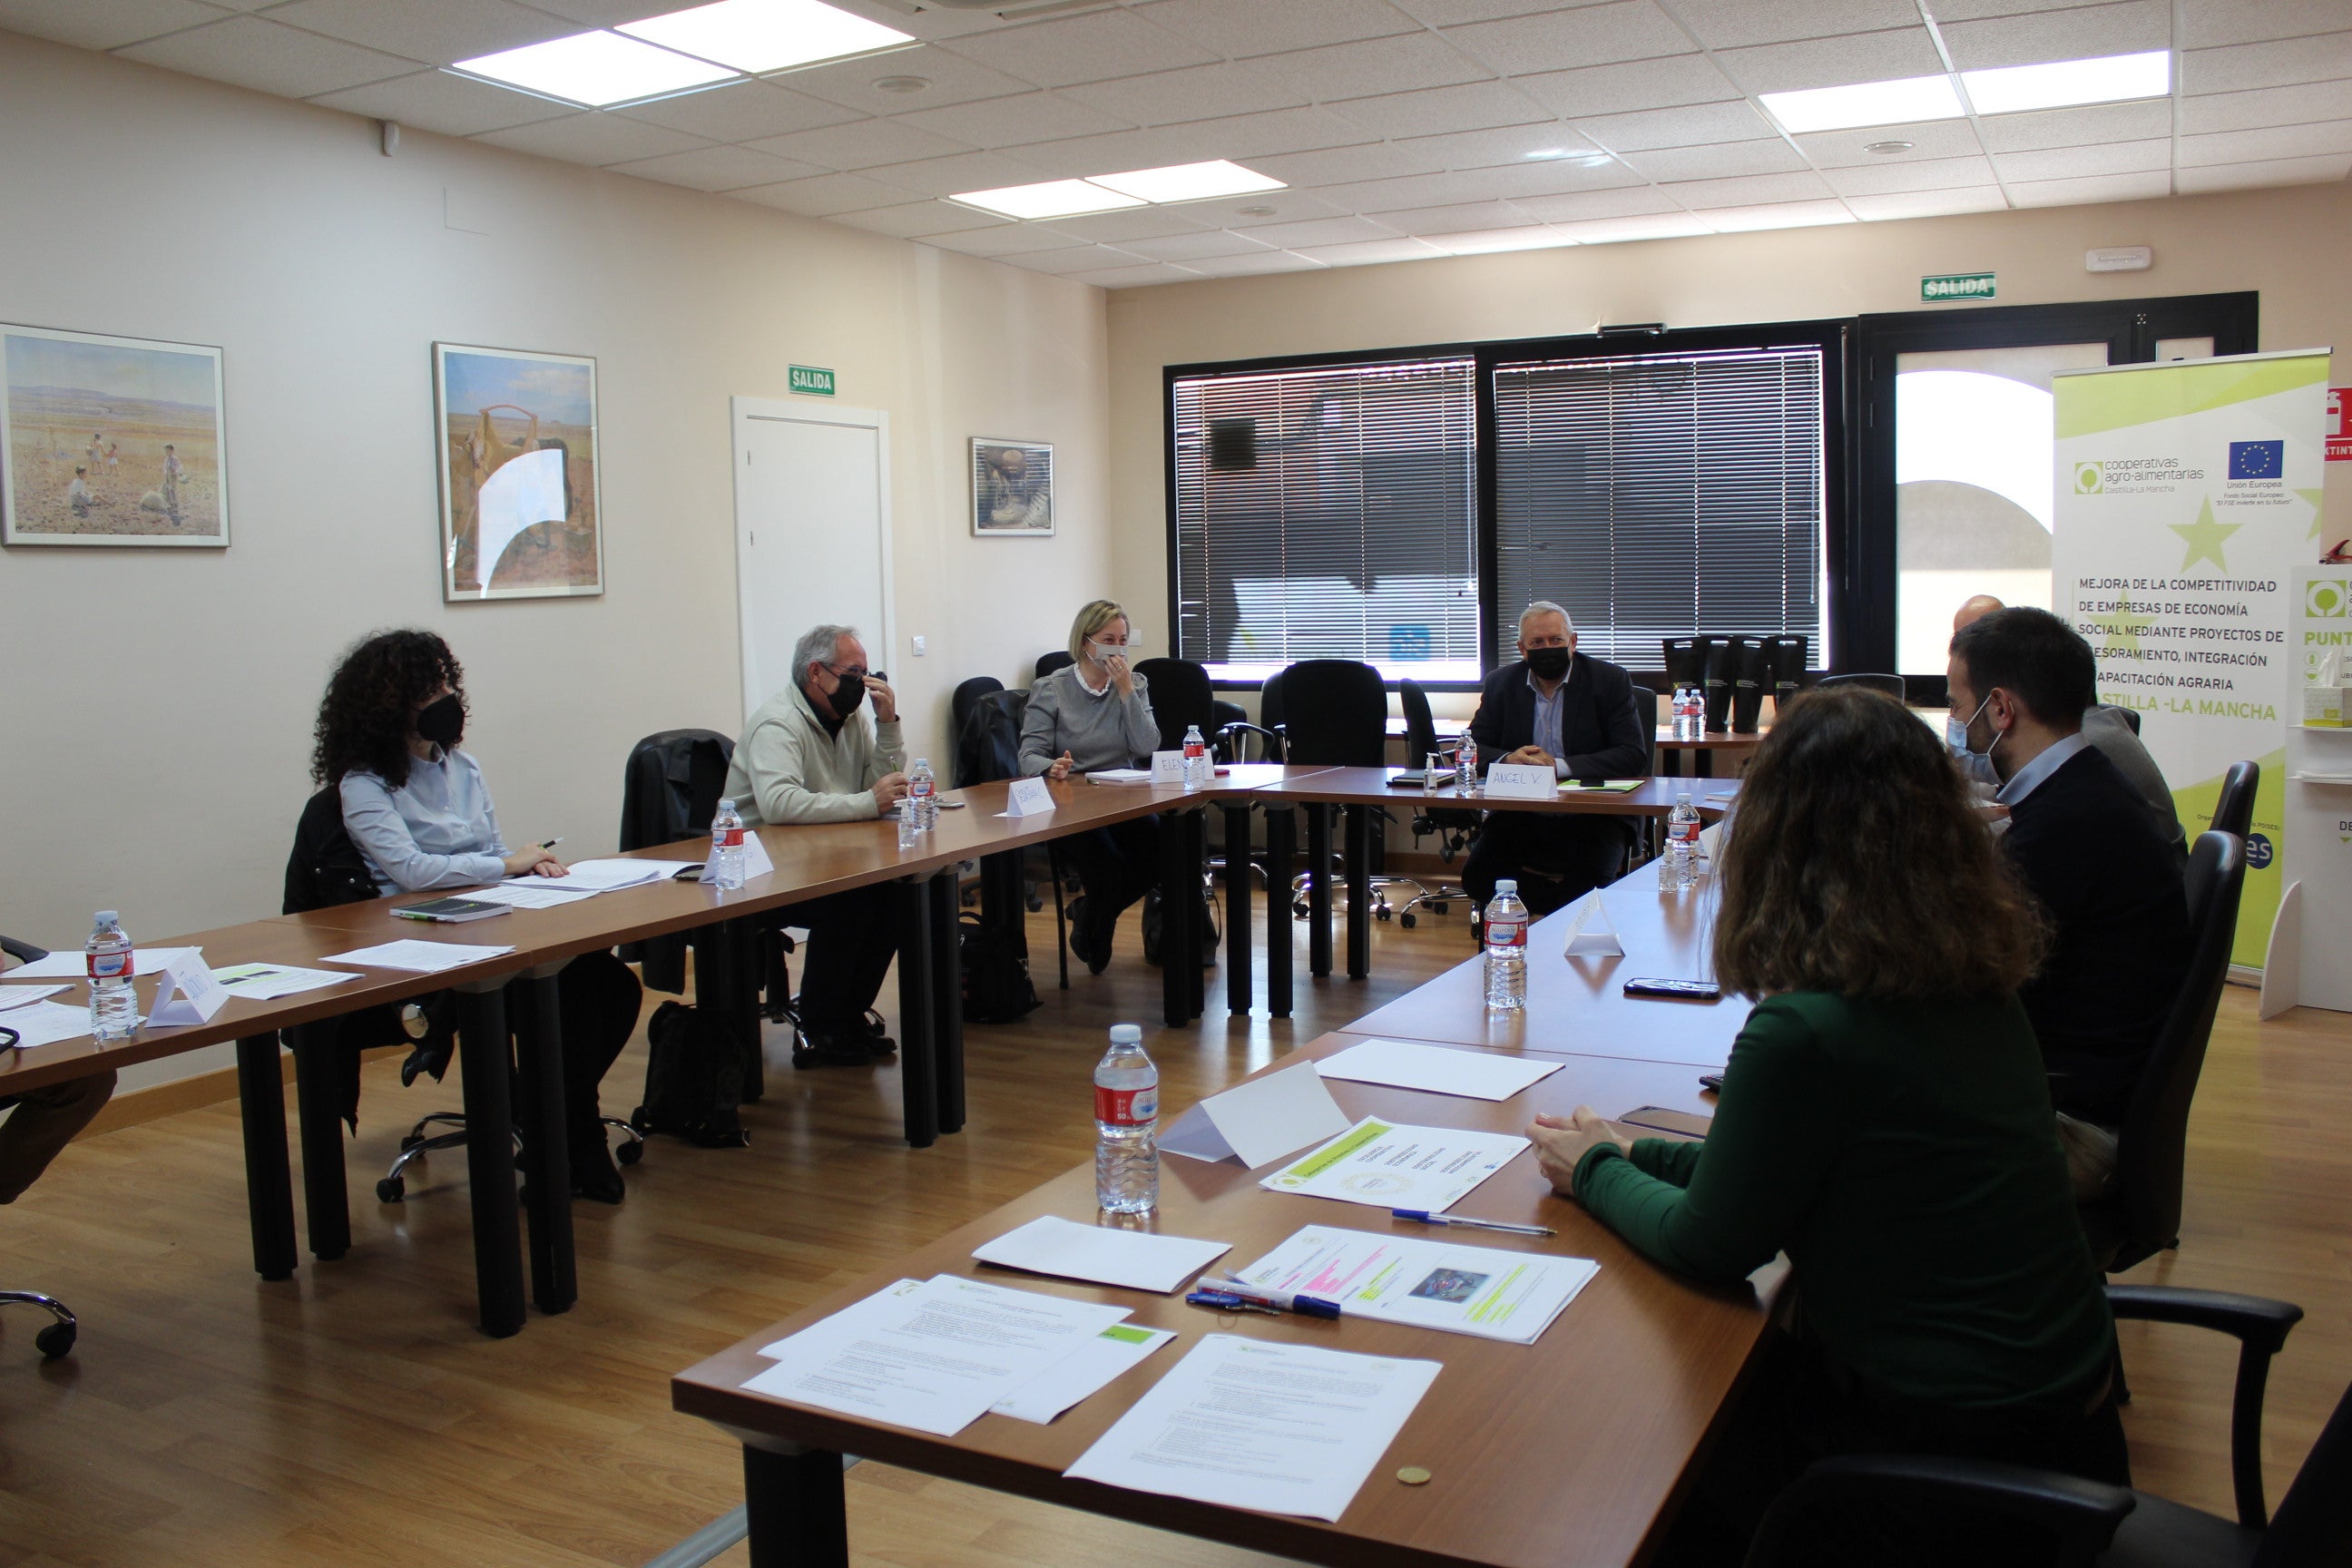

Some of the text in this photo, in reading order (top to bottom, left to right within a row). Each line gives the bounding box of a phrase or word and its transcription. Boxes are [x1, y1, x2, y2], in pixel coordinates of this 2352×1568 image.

[1926, 278, 1988, 296] SALIDA
[792, 370, 831, 389] SALIDA
[2105, 458, 2178, 471] cooperativas
[2105, 469, 2204, 485] agro-alimentarias
[2249, 480, 2282, 490] Europea
[2080, 578, 2277, 592] MEJORA DE LA COMPETITIVIDAD
[2079, 601, 2248, 616] DE EMPRESAS DE ECONOMÍA
[2078, 624, 2283, 642] SOCIAL MEDIANTE PROYECTOS DE
[2094, 647, 2268, 667] ESORAMIENTO, INTEGRACIÓN
[2096, 671, 2233, 691] APACITACIÓN AGRARIA
[2096, 692, 2277, 721] STILLA -LA MANCHA
[1493, 771, 1527, 785] ANGEL
